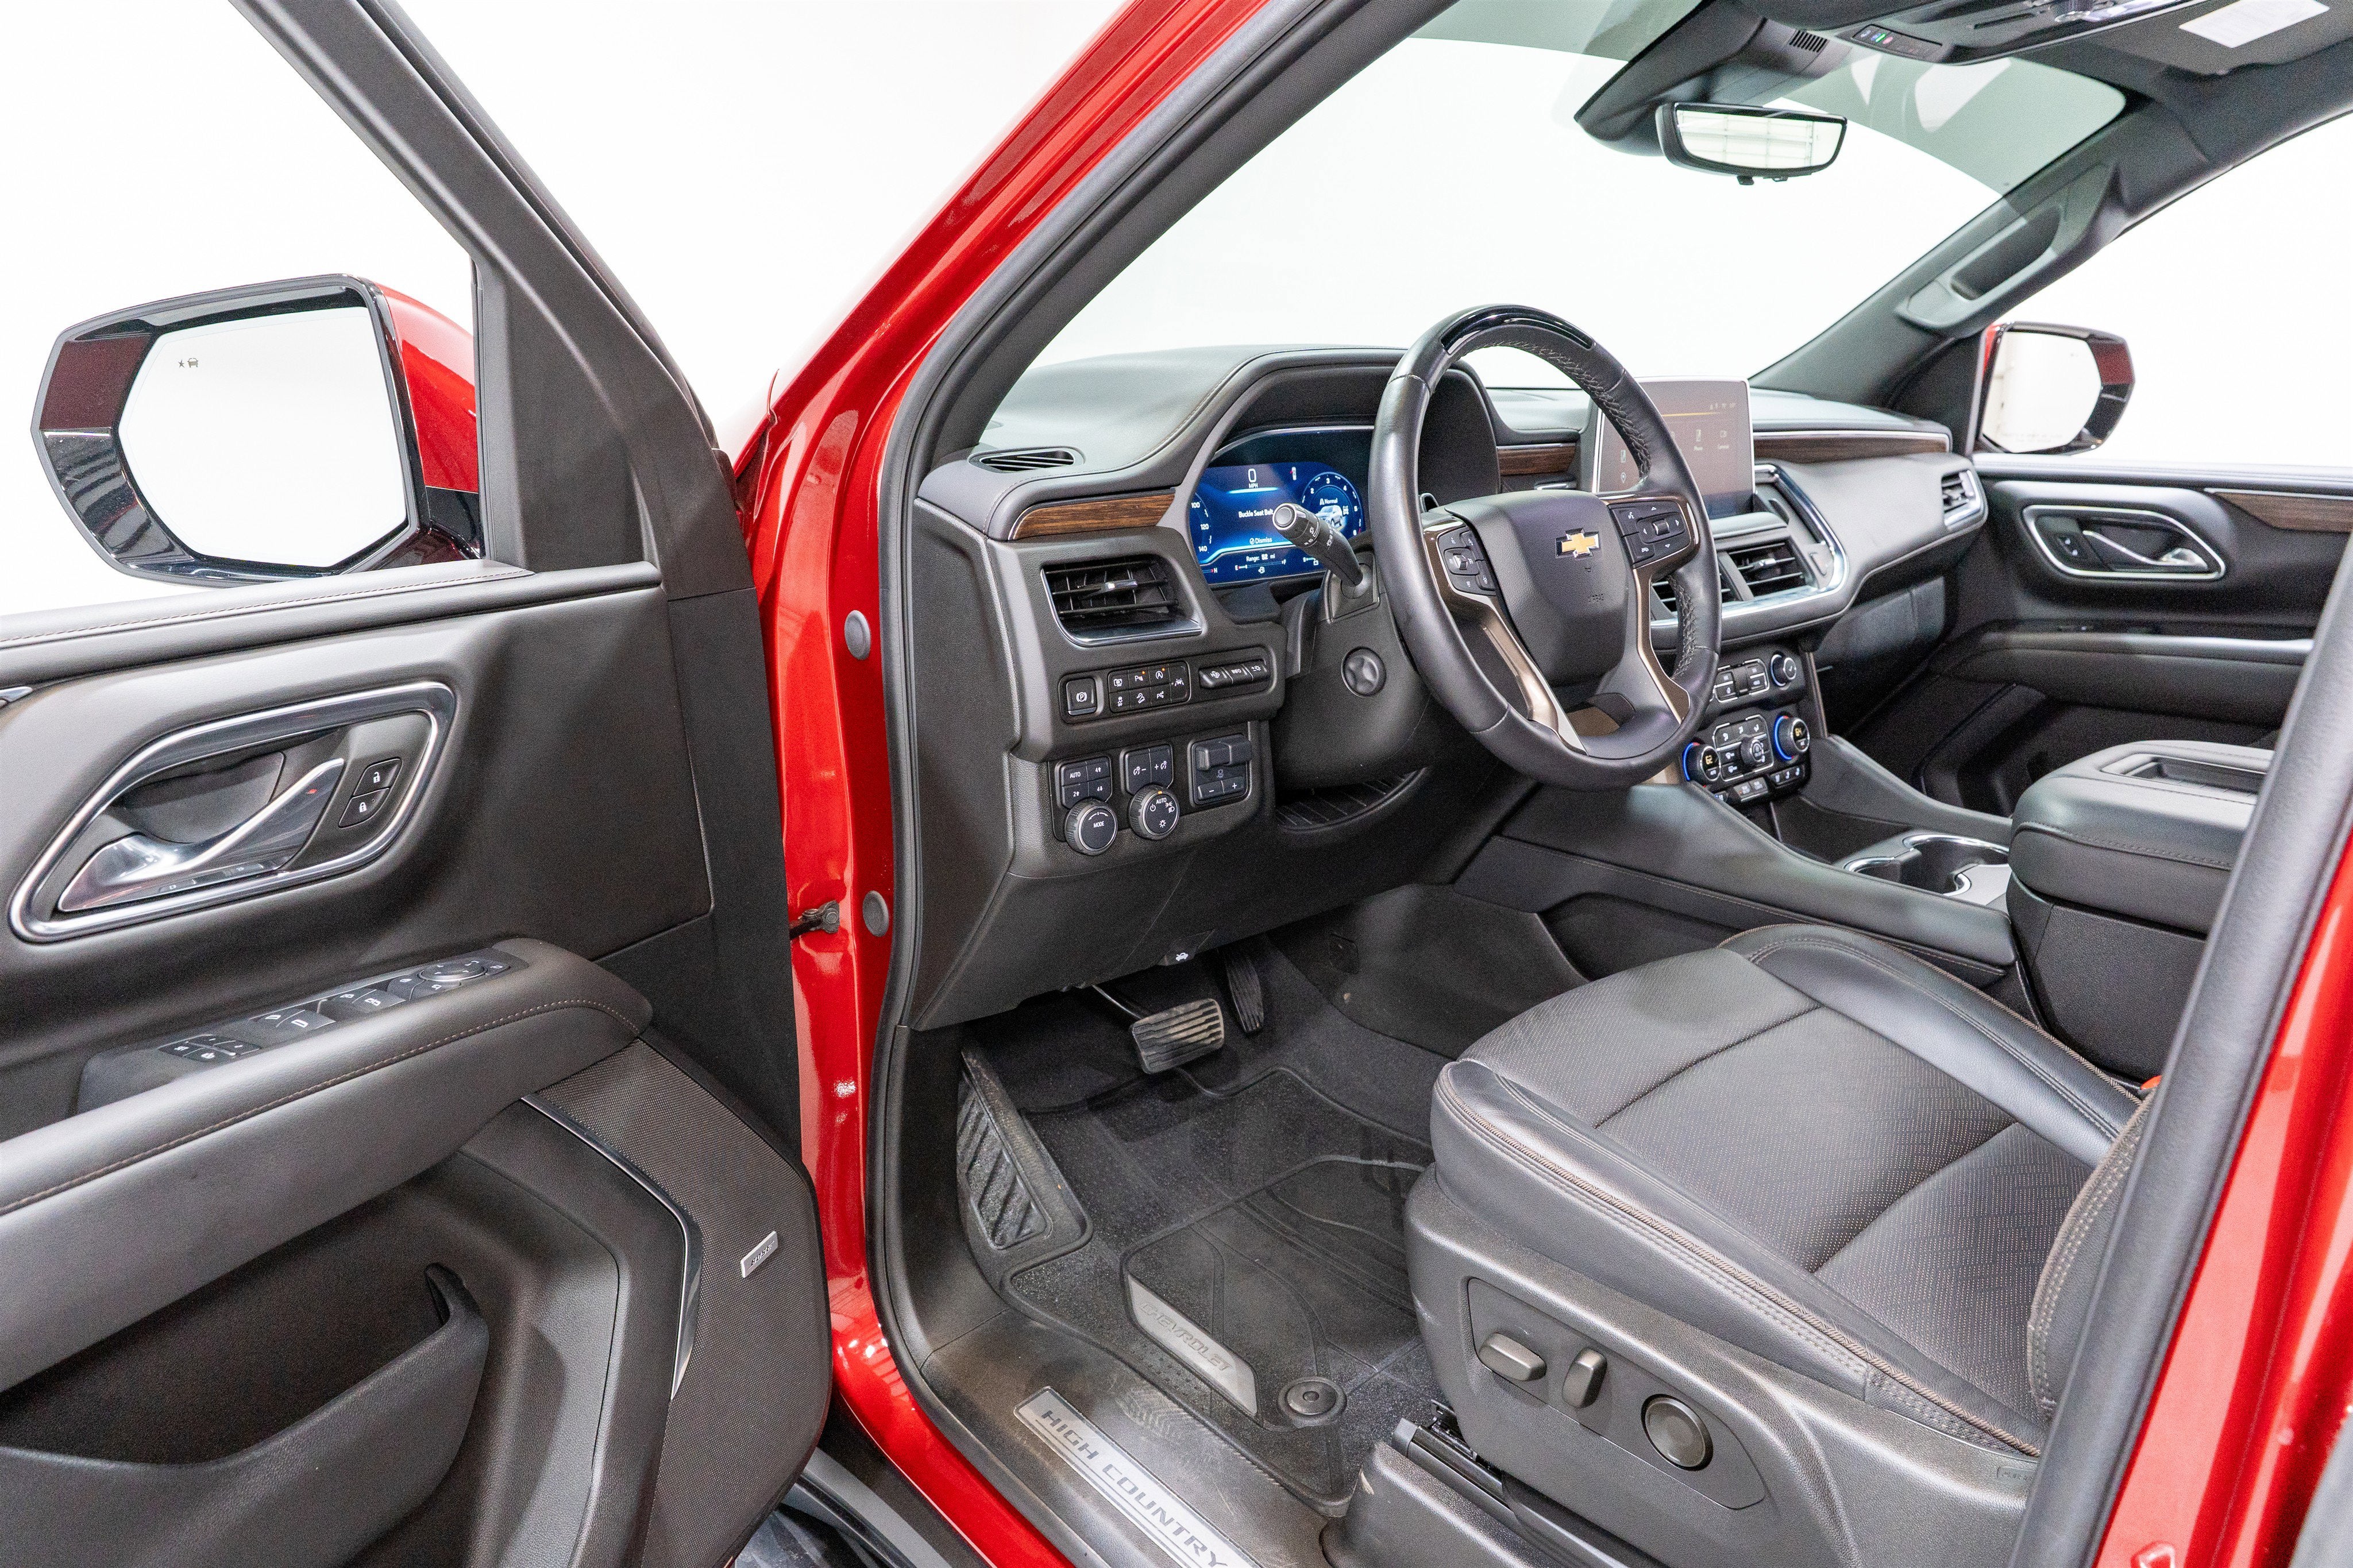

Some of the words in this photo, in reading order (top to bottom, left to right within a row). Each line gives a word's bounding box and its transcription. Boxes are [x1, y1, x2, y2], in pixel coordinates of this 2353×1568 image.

[1248, 468, 1256, 482] 0
[1141, 1302, 1230, 1372] CHEVROLET
[1041, 1409, 1100, 1460] HIGH
[1102, 1463, 1228, 1567] COUNTRY
